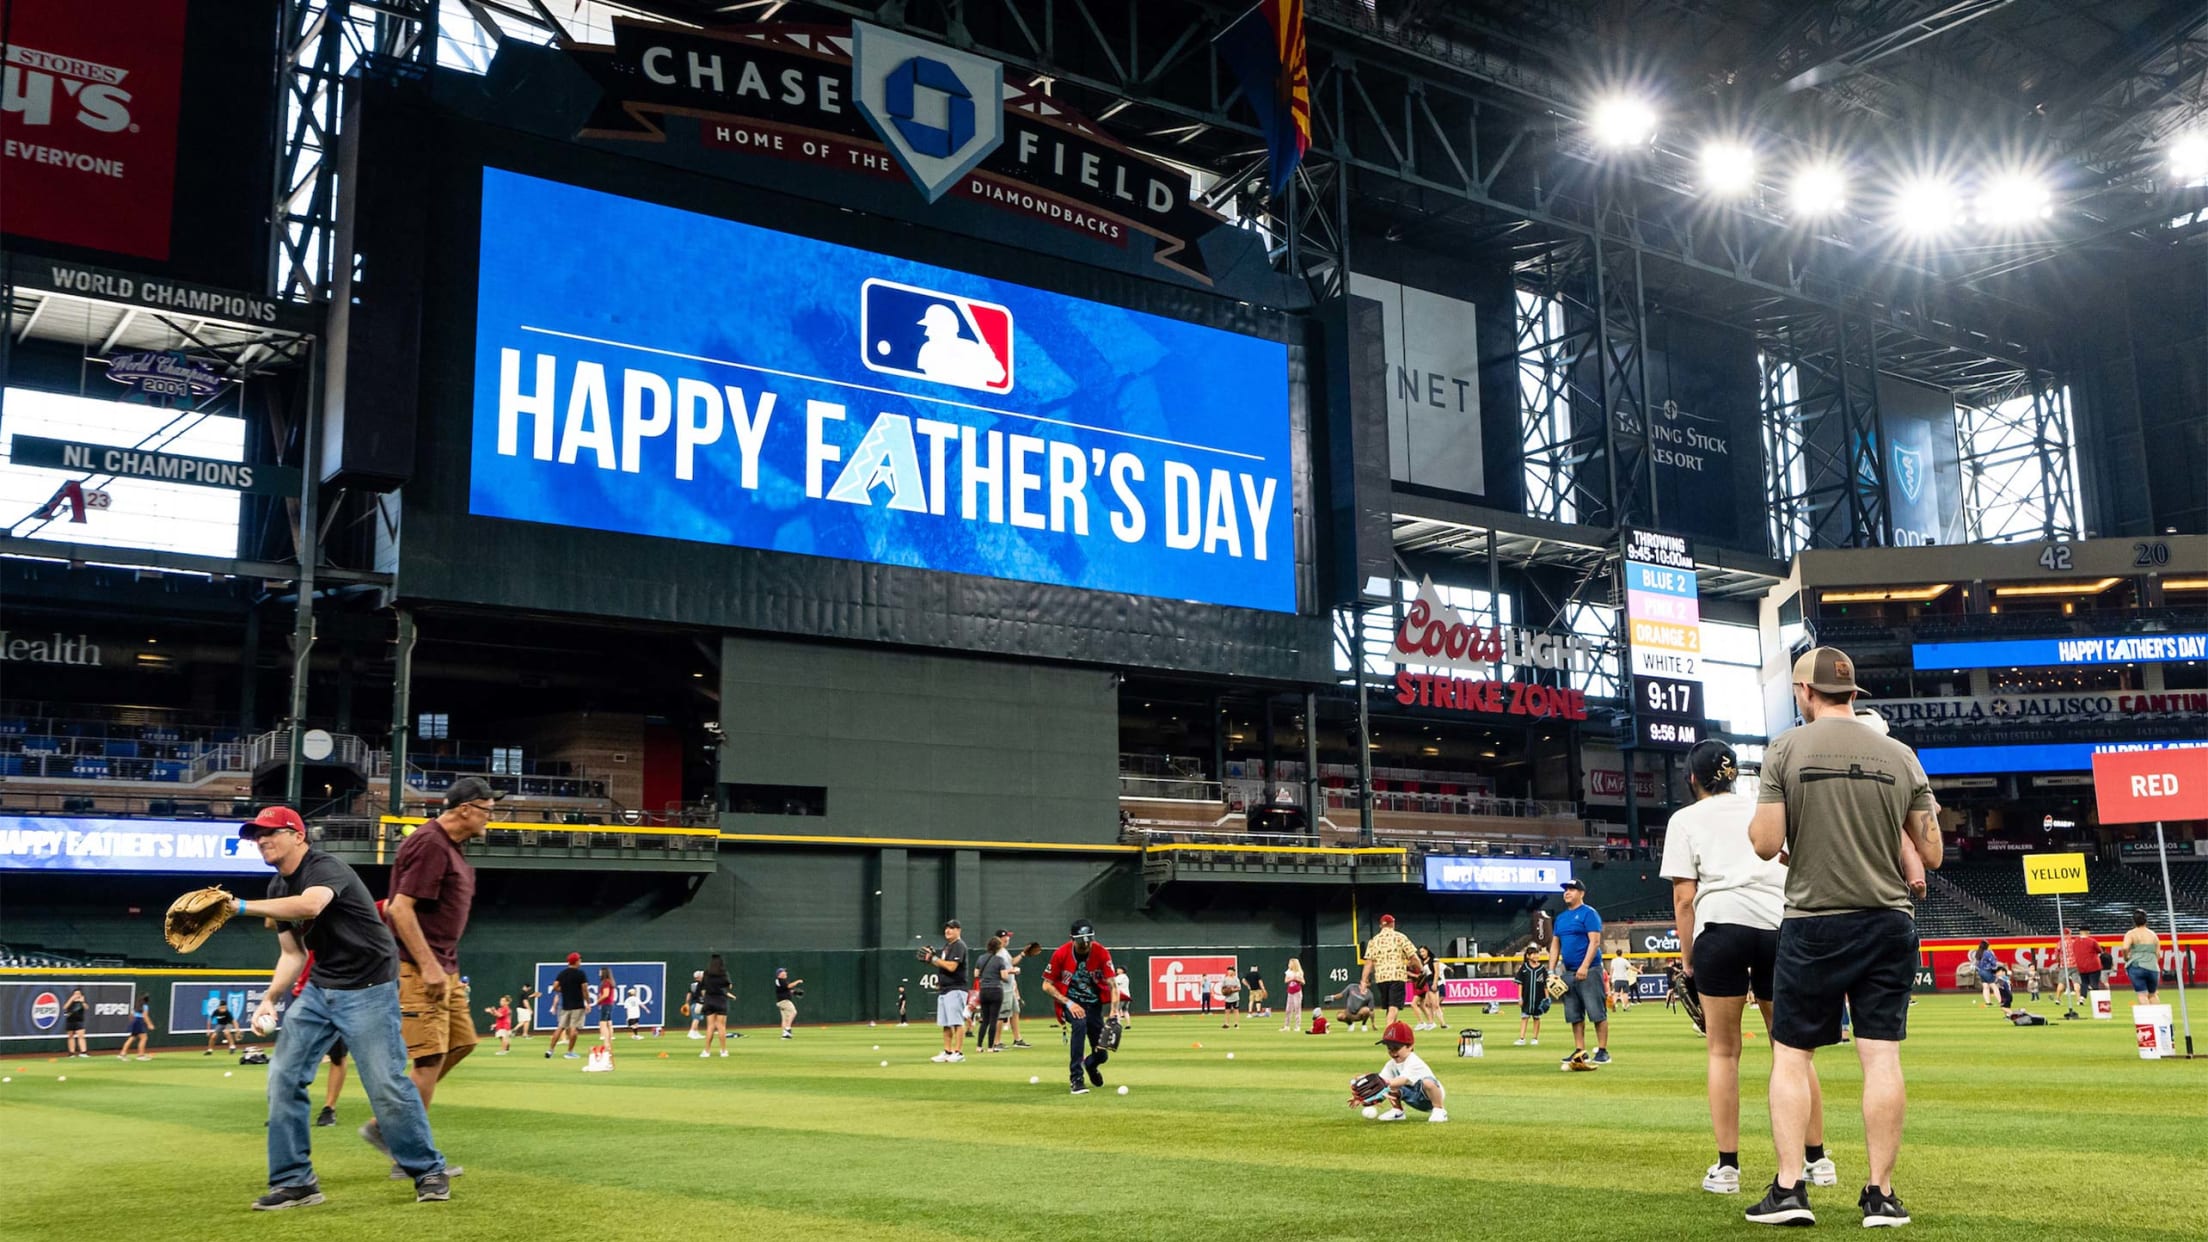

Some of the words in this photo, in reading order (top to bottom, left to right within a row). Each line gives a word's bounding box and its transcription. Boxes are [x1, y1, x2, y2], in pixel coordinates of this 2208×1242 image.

[18, 50, 118, 85] STORES
[642, 46, 842, 114] CHASE
[4, 139, 125, 179] EVERYONE
[717, 126, 784, 151] HOME
[803, 140, 831, 160] OF
[849, 150, 891, 172] THE
[1019, 130, 1174, 214] FIELD
[971, 180, 1121, 240] DIAMONDBACKS
[52, 266, 134, 298] WORLD
[141, 283, 277, 322] CHAMPIONS
[109, 353, 153, 375] World
[143, 379, 188, 397] 2001
[1386, 363, 1470, 412] NET
[63, 444, 96, 470] NL
[104, 450, 254, 488] CHAMPIONS
[496, 346, 777, 491] HAPPY
[805, 398, 1148, 544] FATHER'S
[1165, 459, 1279, 562] DAY
[87, 492, 109, 508] 23
[1633, 530, 1685, 553] THROWING
[2040, 546, 2073, 570] 42
[2134, 543, 2171, 568] 20
[1642, 569, 1673, 591] BLUE
[1677, 574, 1686, 592] 2
[1644, 599, 1674, 619] PINK
[1677, 602, 1687, 620] 2
[1396, 599, 1504, 662] Coors
[1505, 628, 1592, 673] LIGHT
[1636, 623, 1685, 647] ORANGE
[1688, 631, 1697, 649] 2
[2058, 640, 2104, 662] HAPPY
[2106, 638, 2176, 661] FATHER'S
[2178, 636, 2207, 657] DAY
[1643, 653, 1684, 674] WHITE
[1686, 658, 1695, 675] 2
[1396, 671, 1504, 714] STRIKE
[1508, 681, 1588, 721] ZONE
[1648, 681, 1690, 712] 9:17
[2015, 696, 2113, 717] JALISCO
[1677, 726, 1695, 744] AM
[2130, 773, 2179, 797] RED
[177, 834, 220, 858] DAY
[2031, 867, 2081, 881] YELLOW
[919, 974, 939, 989] 40
[1330, 968, 1348, 982] 413
[1449, 980, 1498, 998] Mobile
[95, 1004, 130, 1016] PEPSI
